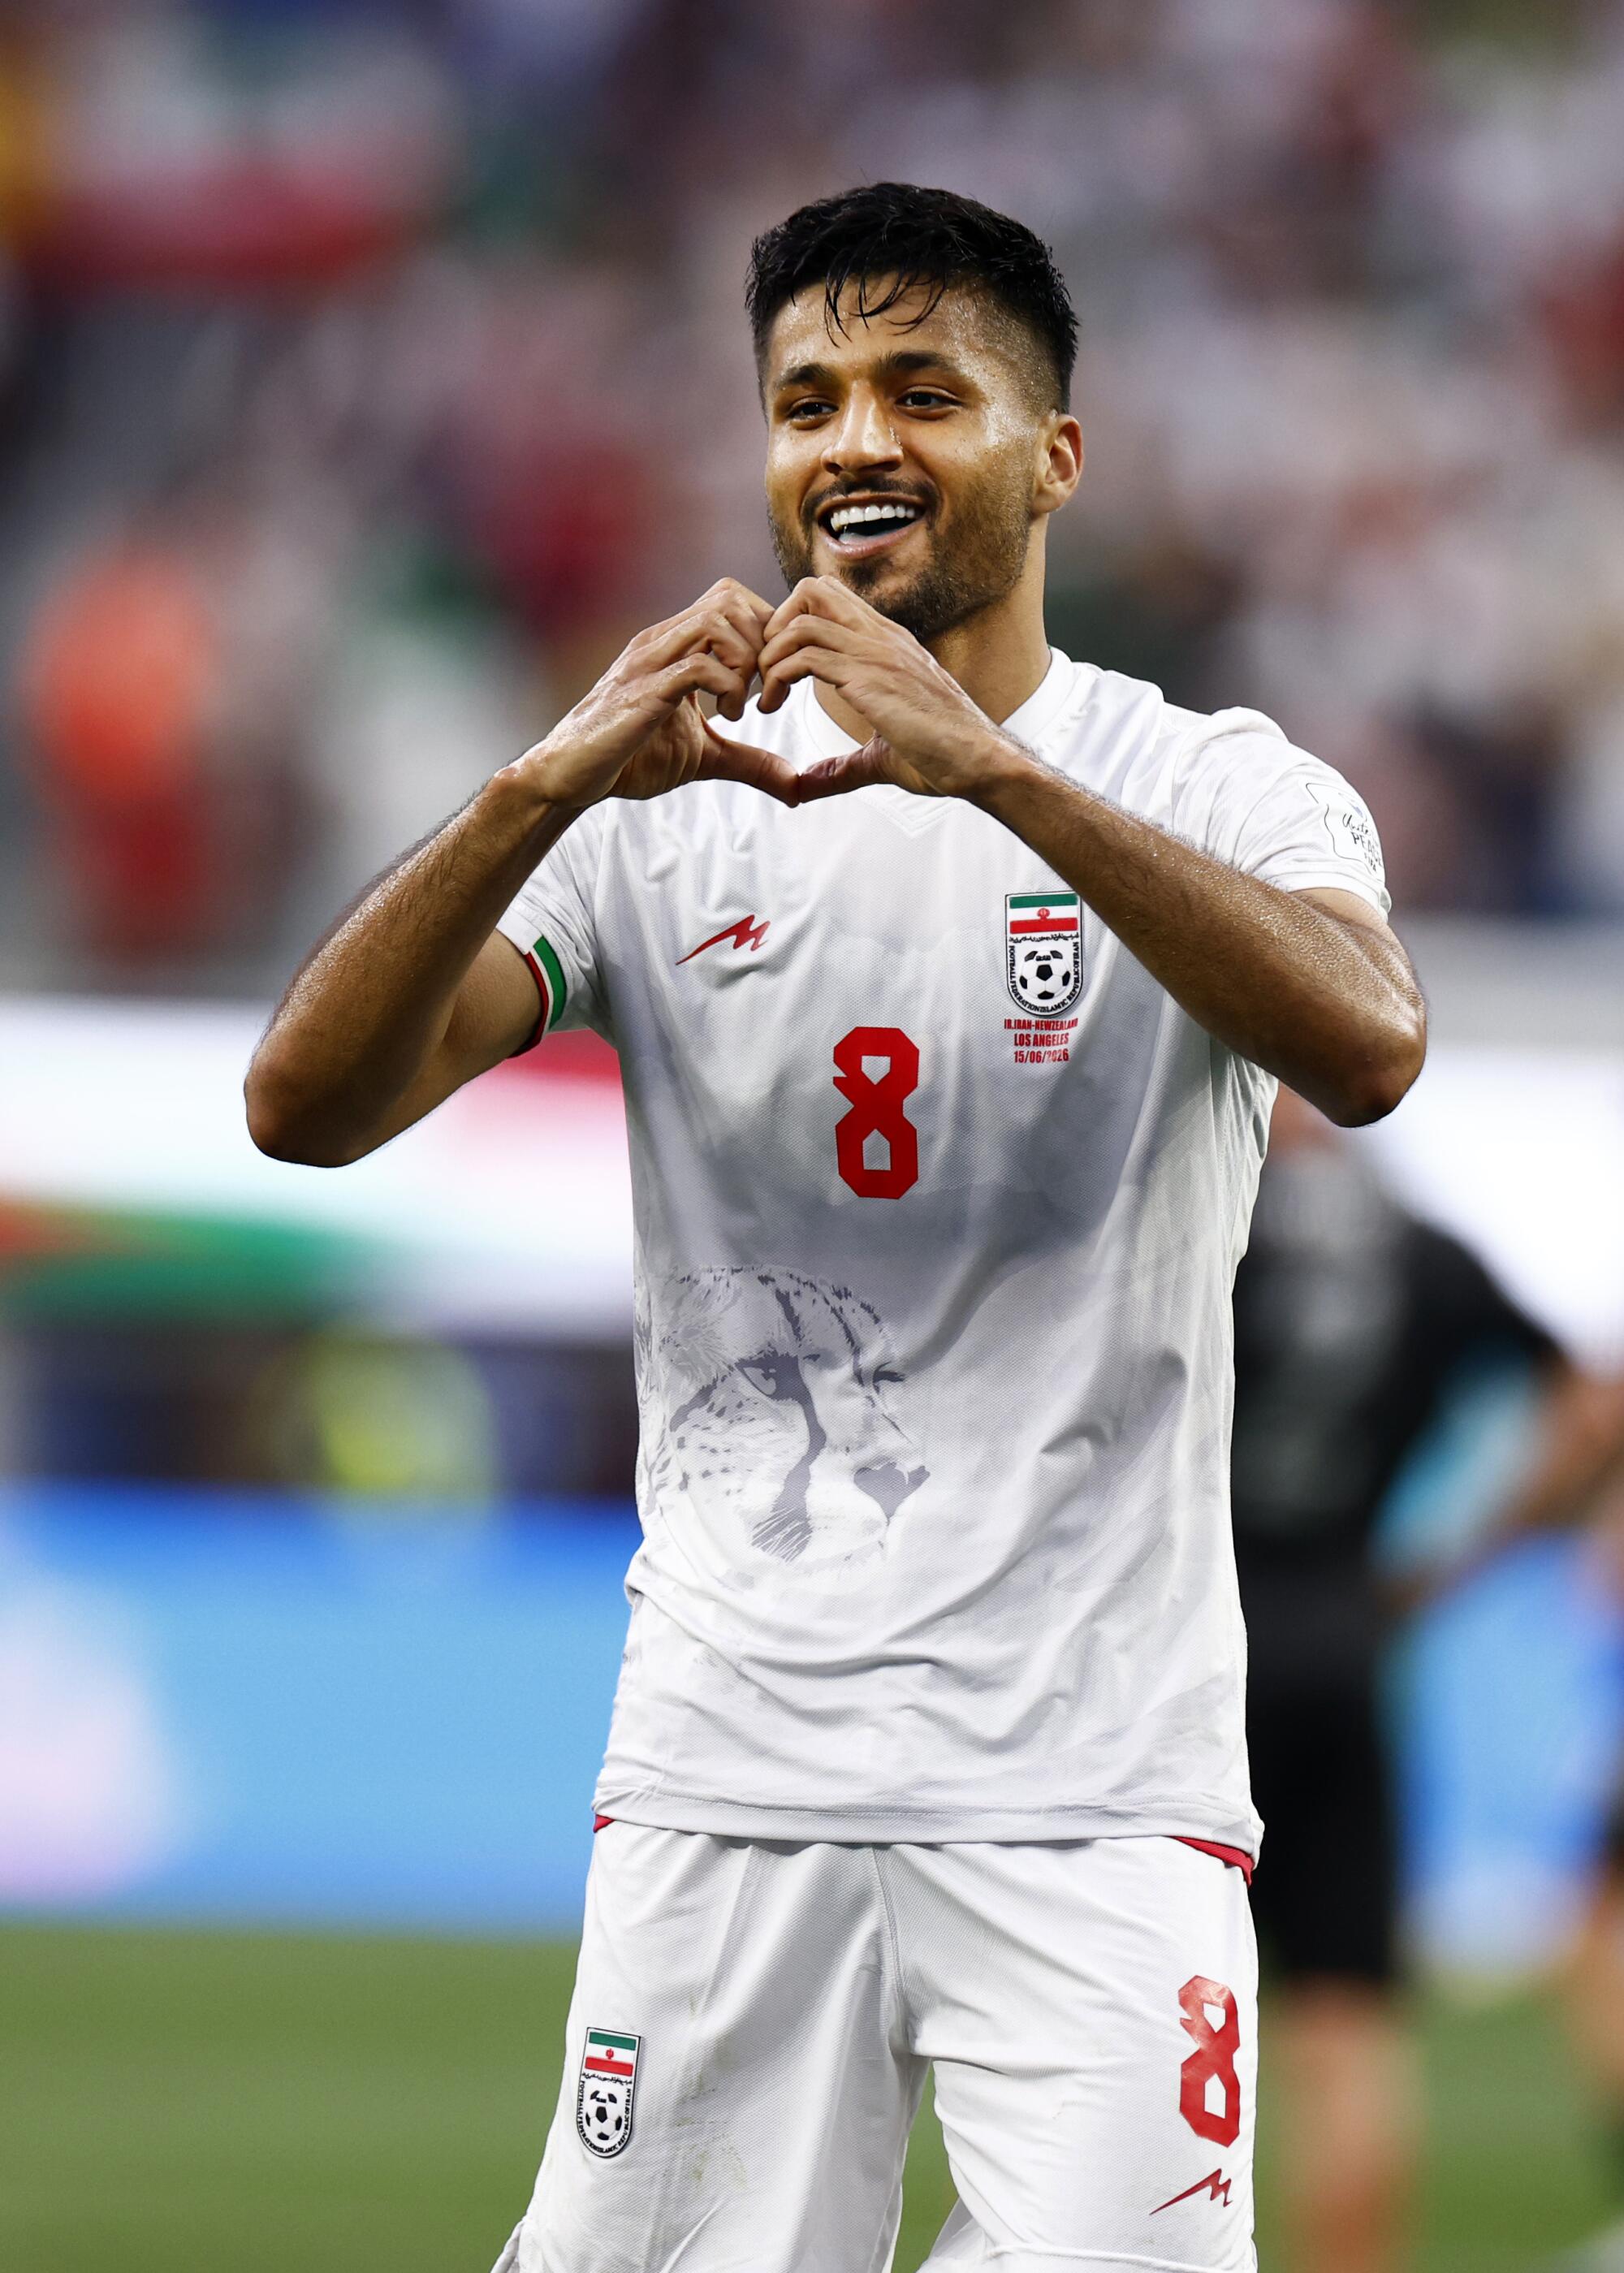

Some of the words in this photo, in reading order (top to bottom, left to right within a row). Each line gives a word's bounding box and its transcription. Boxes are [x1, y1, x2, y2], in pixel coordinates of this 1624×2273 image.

[1014, 1033, 1030, 1047] LOS
[1033, 1032, 1069, 1047] ANGELES
[1014, 1048, 1069, 1063] 15/06/2026
[833, 1026, 919, 1199] 8
[1178, 1975, 1240, 2148] 8
